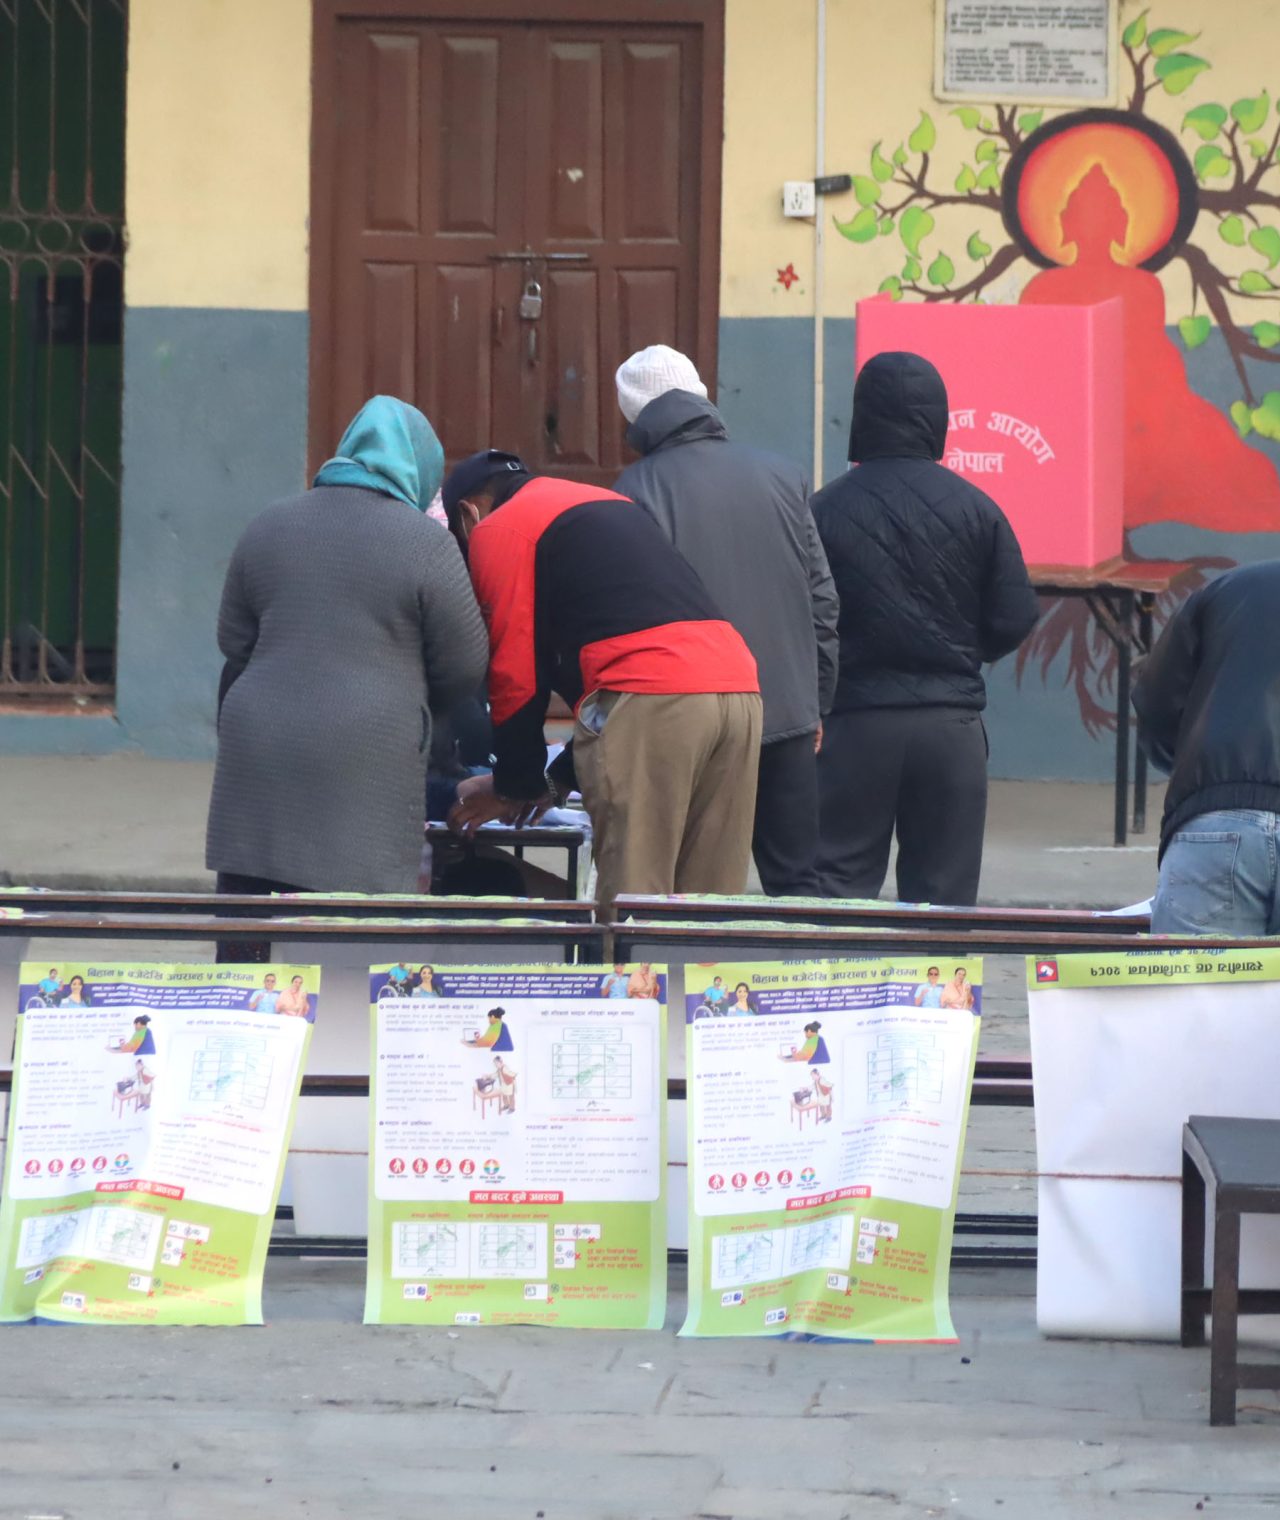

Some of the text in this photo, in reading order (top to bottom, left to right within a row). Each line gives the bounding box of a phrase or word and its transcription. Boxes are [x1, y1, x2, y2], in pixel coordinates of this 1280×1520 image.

[986, 411, 1056, 465] आयोग
[946, 447, 1005, 473] नेपाल
[87, 967, 115, 978] बिहान
[127, 968, 163, 980] बजेदेखि
[1090, 966, 1121, 977] २०८१
[1195, 963, 1213, 973] तह
[1217, 961, 1264, 974] स्थानीय
[752, 973, 779, 984] बिहान
[792, 970, 827, 983] बजेदेखि
[474, 1191, 560, 1203] मत बदर हुने अवस्था
